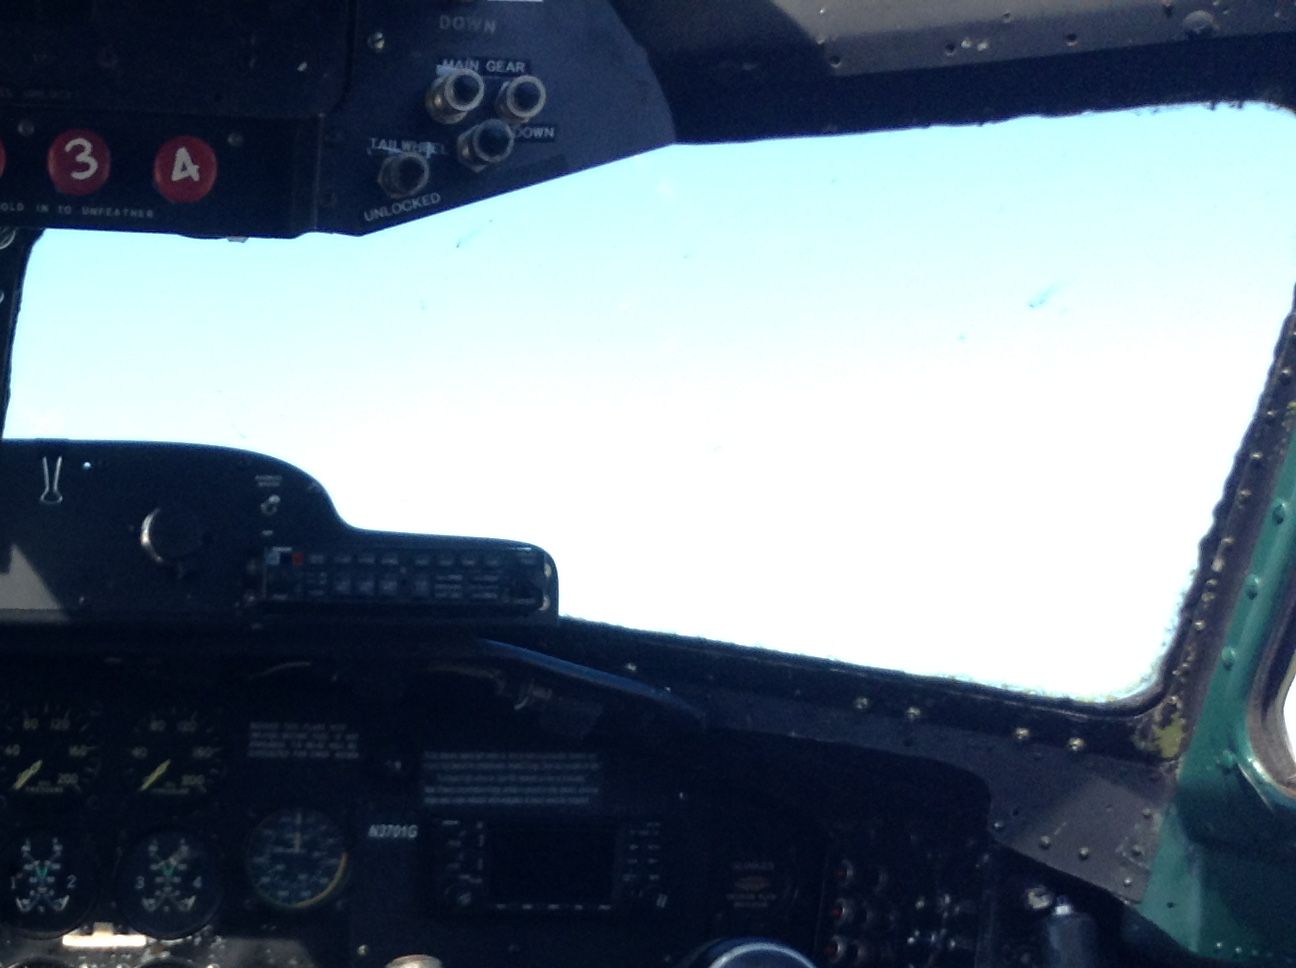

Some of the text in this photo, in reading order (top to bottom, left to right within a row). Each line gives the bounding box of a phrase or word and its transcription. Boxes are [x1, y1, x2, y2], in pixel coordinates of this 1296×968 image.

[439, 14, 496, 34] DOWN
[486, 59, 526, 73] GEAR
[64, 138, 98, 180] 3
[170, 146, 201, 182] 4
[81, 206, 154, 219] UNFEATHER
[364, 192, 441, 222] UNLOCKED
[66, 874, 78, 889] 2
